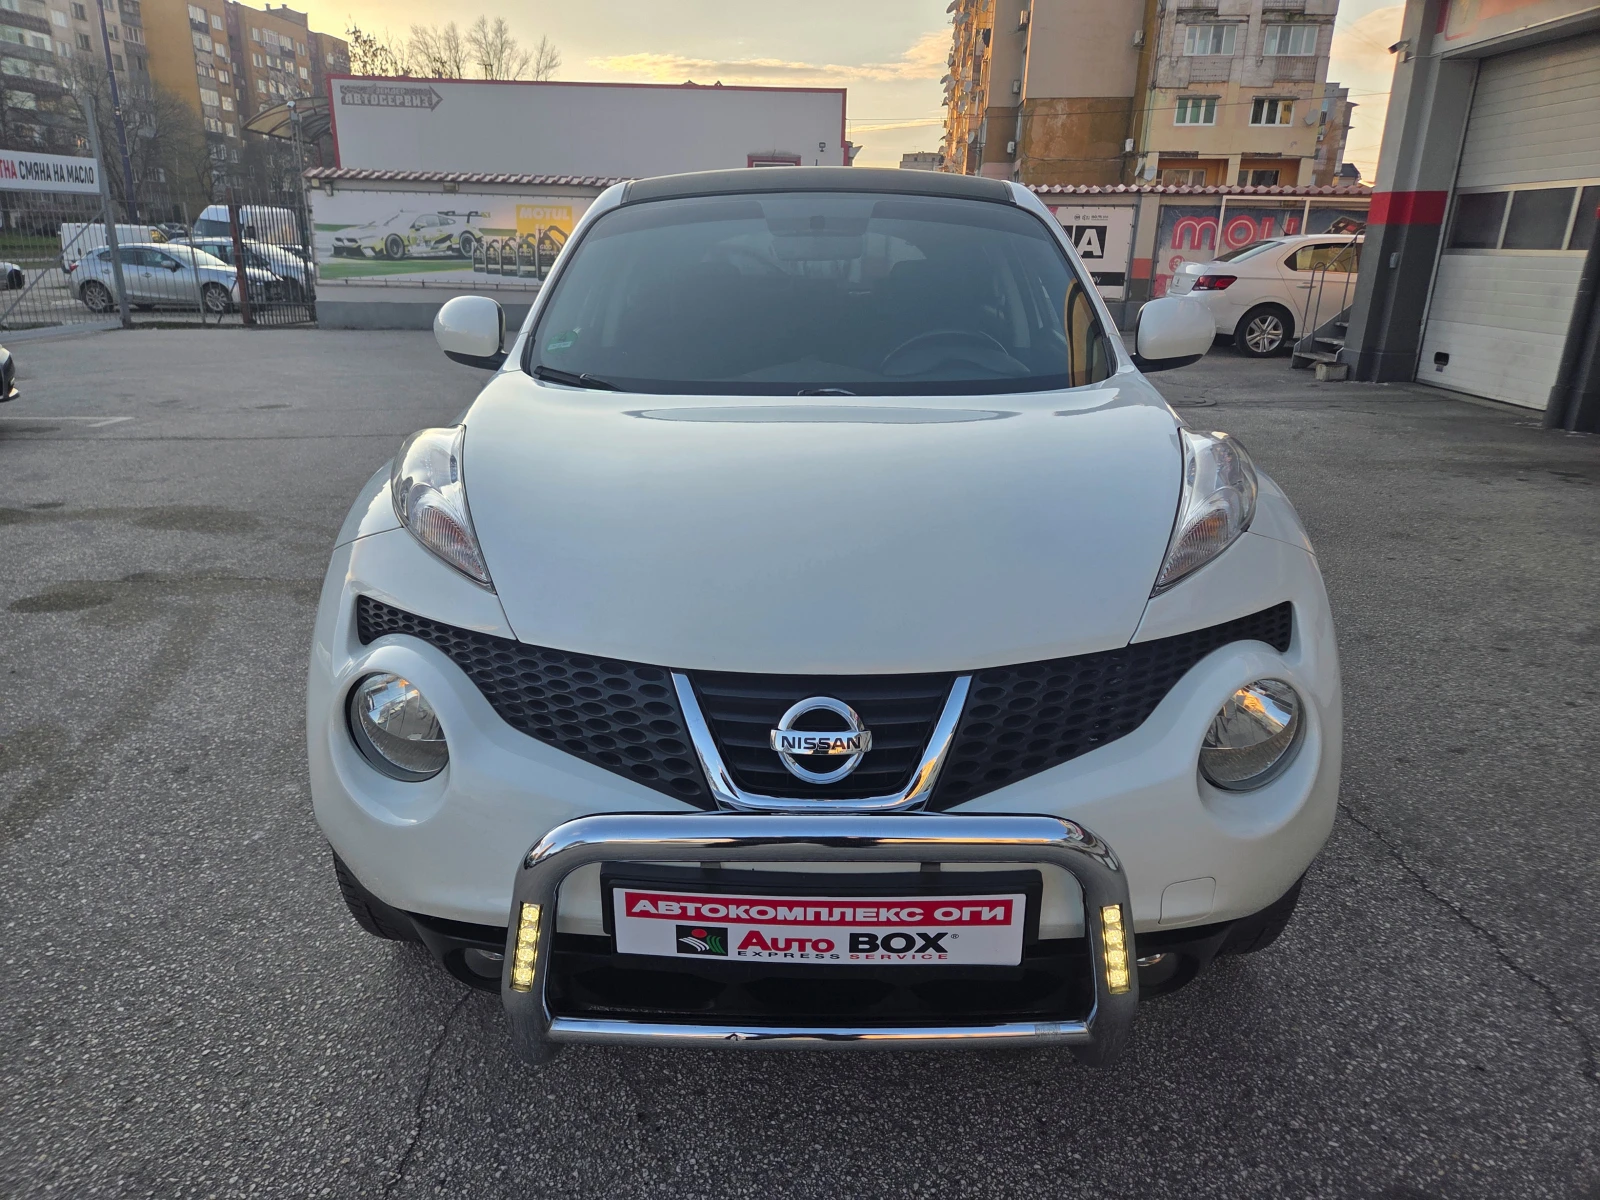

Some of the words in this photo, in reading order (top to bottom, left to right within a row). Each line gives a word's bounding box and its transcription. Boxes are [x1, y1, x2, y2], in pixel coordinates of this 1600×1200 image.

[344, 93, 429, 107] АВТОСЕРВИЗ
[18, 160, 52, 181] СМЯНА
[53, 162, 65, 182] НА
[66, 164, 94, 184] МАСЛО
[519, 207, 570, 220] MOTUL
[781, 735, 861, 750] NISSAN
[631, 899, 925, 922] АВТОКОМПЛЕКС
[933, 906, 1005, 922] ОГИ
[737, 951, 840, 960] EXPRESS
